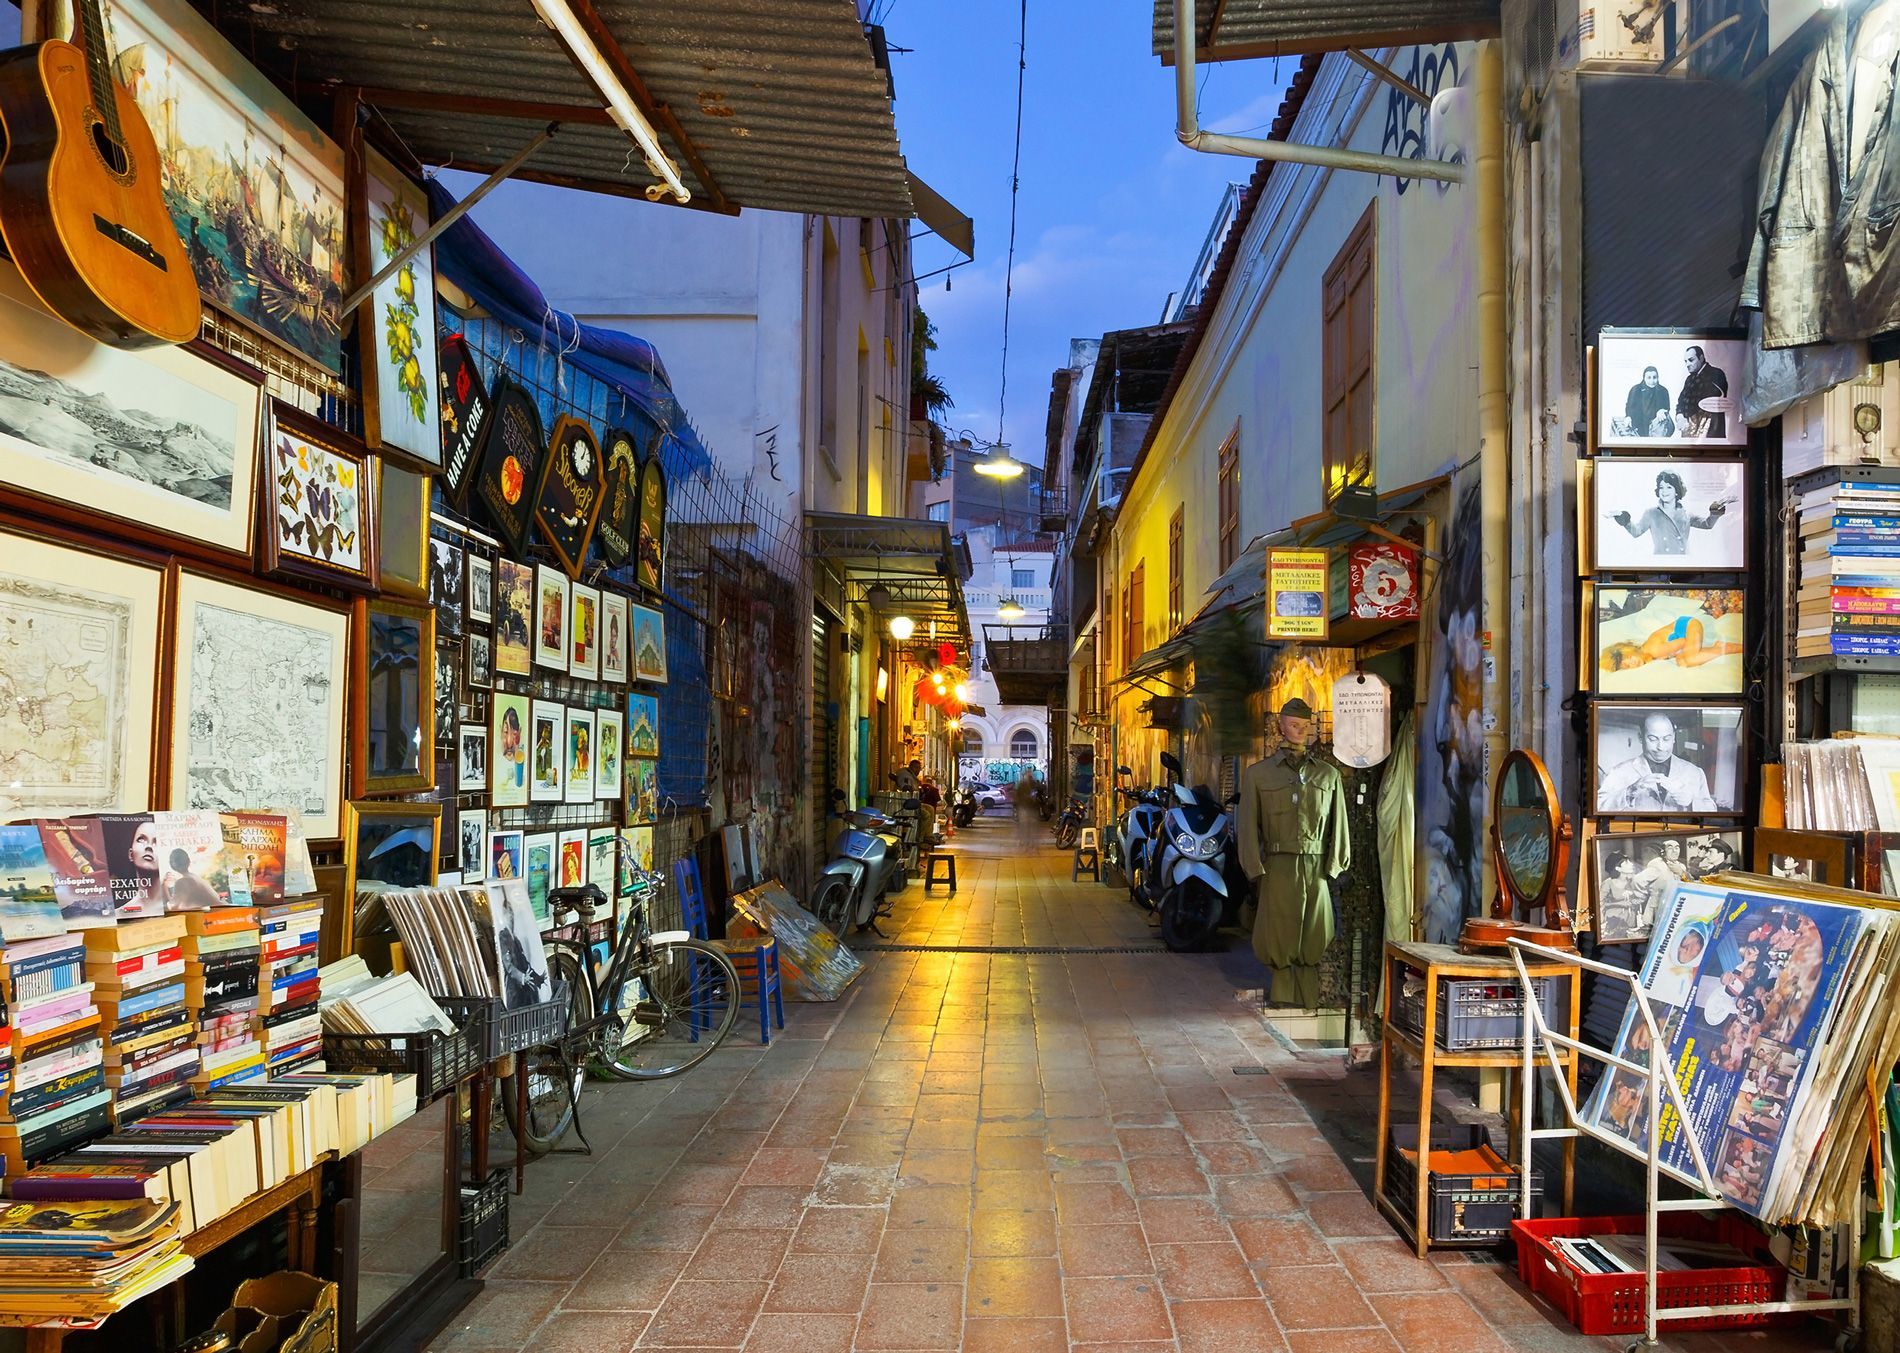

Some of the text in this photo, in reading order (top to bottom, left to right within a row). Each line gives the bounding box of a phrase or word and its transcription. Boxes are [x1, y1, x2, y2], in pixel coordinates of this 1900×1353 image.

[446, 396, 484, 490] HAVE A COKE
[601, 521, 617, 542] GOLF
[166, 813, 204, 823] ΜΑΡΙΝΑ
[248, 819, 284, 827] ΚΟΝΔΥΛΗΣ
[239, 828, 274, 836] ΚΛΗΜΑ
[160, 836, 213, 847] ΚΥΡΙΑΚΕΣ
[250, 836, 283, 845] ΑΡΧΑΙΑ
[241, 843, 279, 851] ΦΙΠΟΛΗ
[110, 877, 152, 889] ΕΣΧΑΤΟΙ
[75, 885, 107, 896] συρτάρι
[114, 889, 149, 900] ΚΑΙΡΟΙ
[230, 1000, 252, 1010] SPECIALS
[1664, 1055, 1700, 1143] ΚΑΤΟΡΙΑΣ
